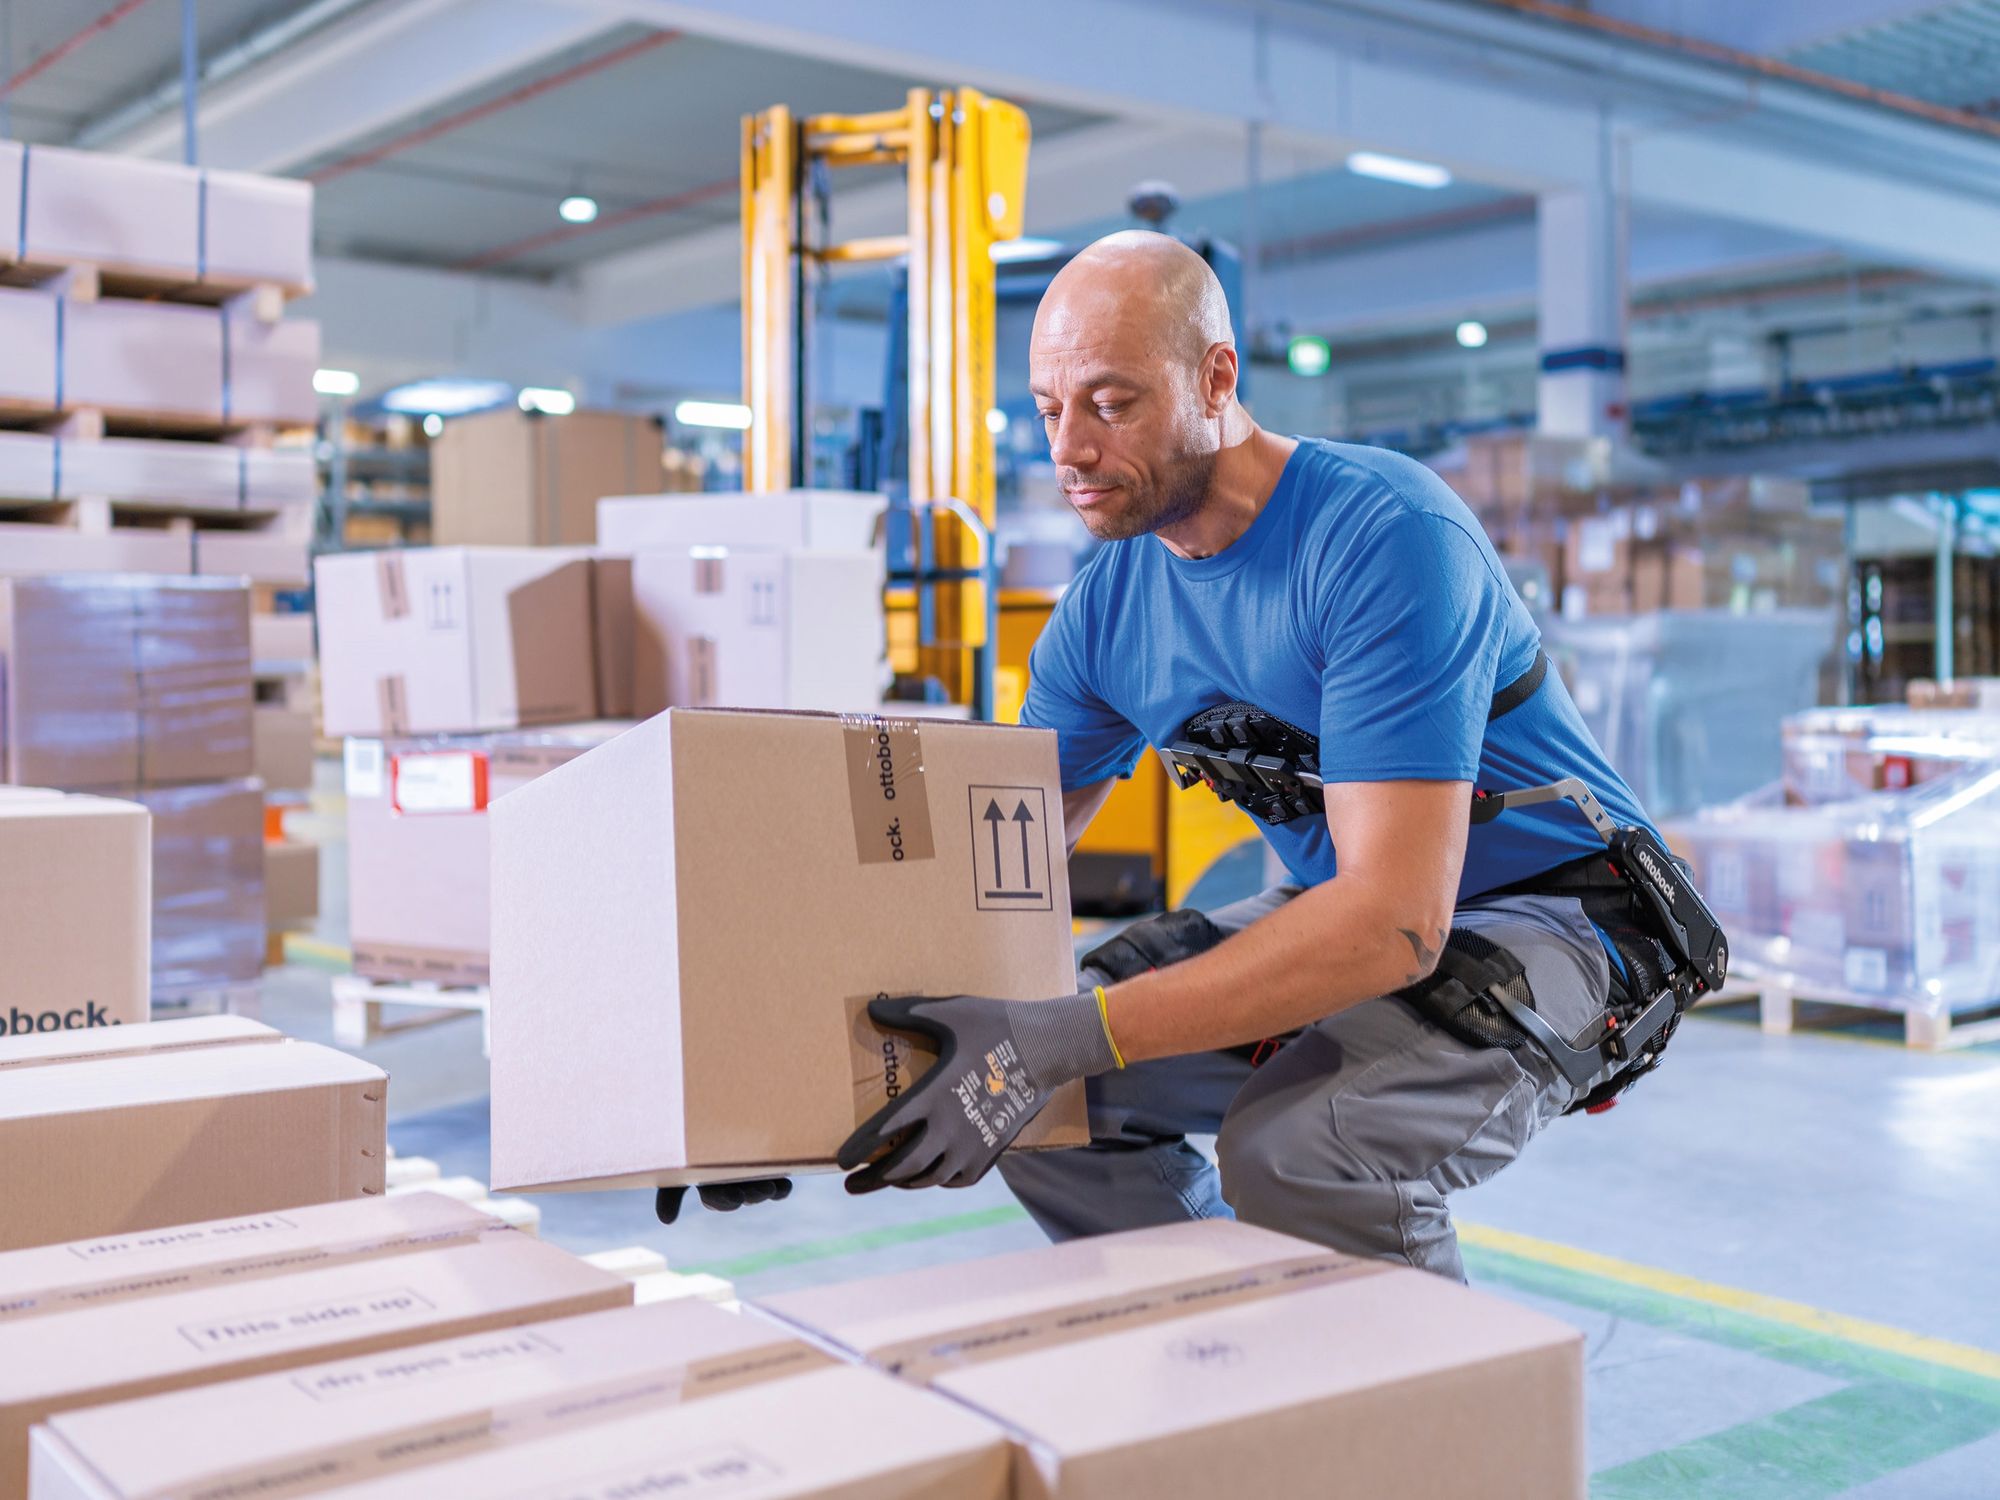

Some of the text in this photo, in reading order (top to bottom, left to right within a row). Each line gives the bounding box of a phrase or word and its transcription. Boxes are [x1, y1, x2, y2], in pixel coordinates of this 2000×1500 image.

[877, 727, 904, 861] ock. ottobo
[1639, 850, 1675, 904] ottobock.
[0, 1000, 122, 1037] bock.
[882, 1041, 901, 1099] ottob
[954, 1083, 999, 1148] MaxiFlex
